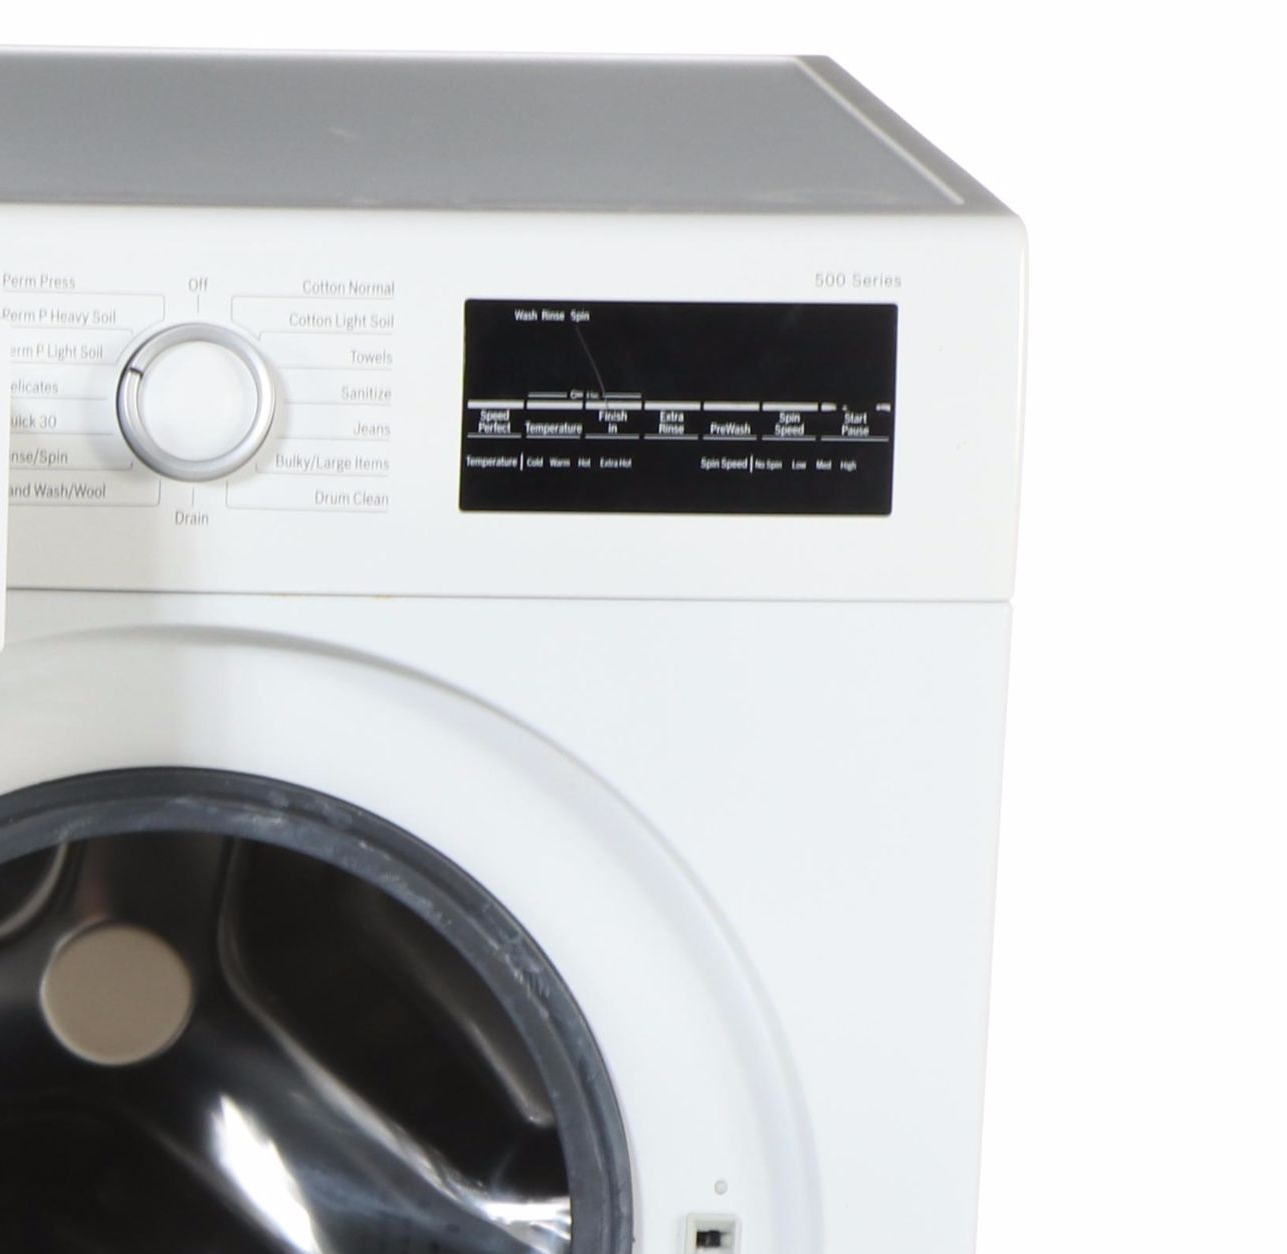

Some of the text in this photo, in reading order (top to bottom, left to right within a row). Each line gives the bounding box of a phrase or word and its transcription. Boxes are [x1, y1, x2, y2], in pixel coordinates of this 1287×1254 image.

[3, 273, 75, 289] Perm Press
[188, 278, 208, 292] Off
[815, 273, 901, 288] 500 Series
[303, 280, 395, 296] Cotton Normal
[2, 308, 116, 326] Perm P Heavy Soil
[289, 312, 394, 330] Cotton Light Soil
[515, 310, 589, 322] Wash Rinse Spin
[11, 344, 105, 362] erm P Light Soil
[351, 350, 393, 364] Towels
[11, 379, 58, 394] elicates
[341, 386, 391, 400] Sanitize
[11, 415, 56, 428] uick 30
[479, 409, 510, 423] Speed
[598, 409, 630, 421] Finish
[660, 410, 683, 423] Extra
[779, 411, 800, 424] Spin
[845, 413, 867, 424] Start
[353, 421, 391, 436] Jeans
[479, 422, 510, 433] Perfect
[525, 421, 583, 435] Temperature
[659, 423, 684, 434] Rinse
[711, 423, 750, 436] PreWash
[775, 424, 804, 438] Speed
[842, 424, 869, 436] Pause
[11, 450, 67, 467] nse/Spin
[276, 455, 389, 473] Bulky/Large Items
[10, 483, 105, 500] and Wash/Wool
[315, 490, 389, 506] Drum Clean
[175, 510, 209, 526] Drain
